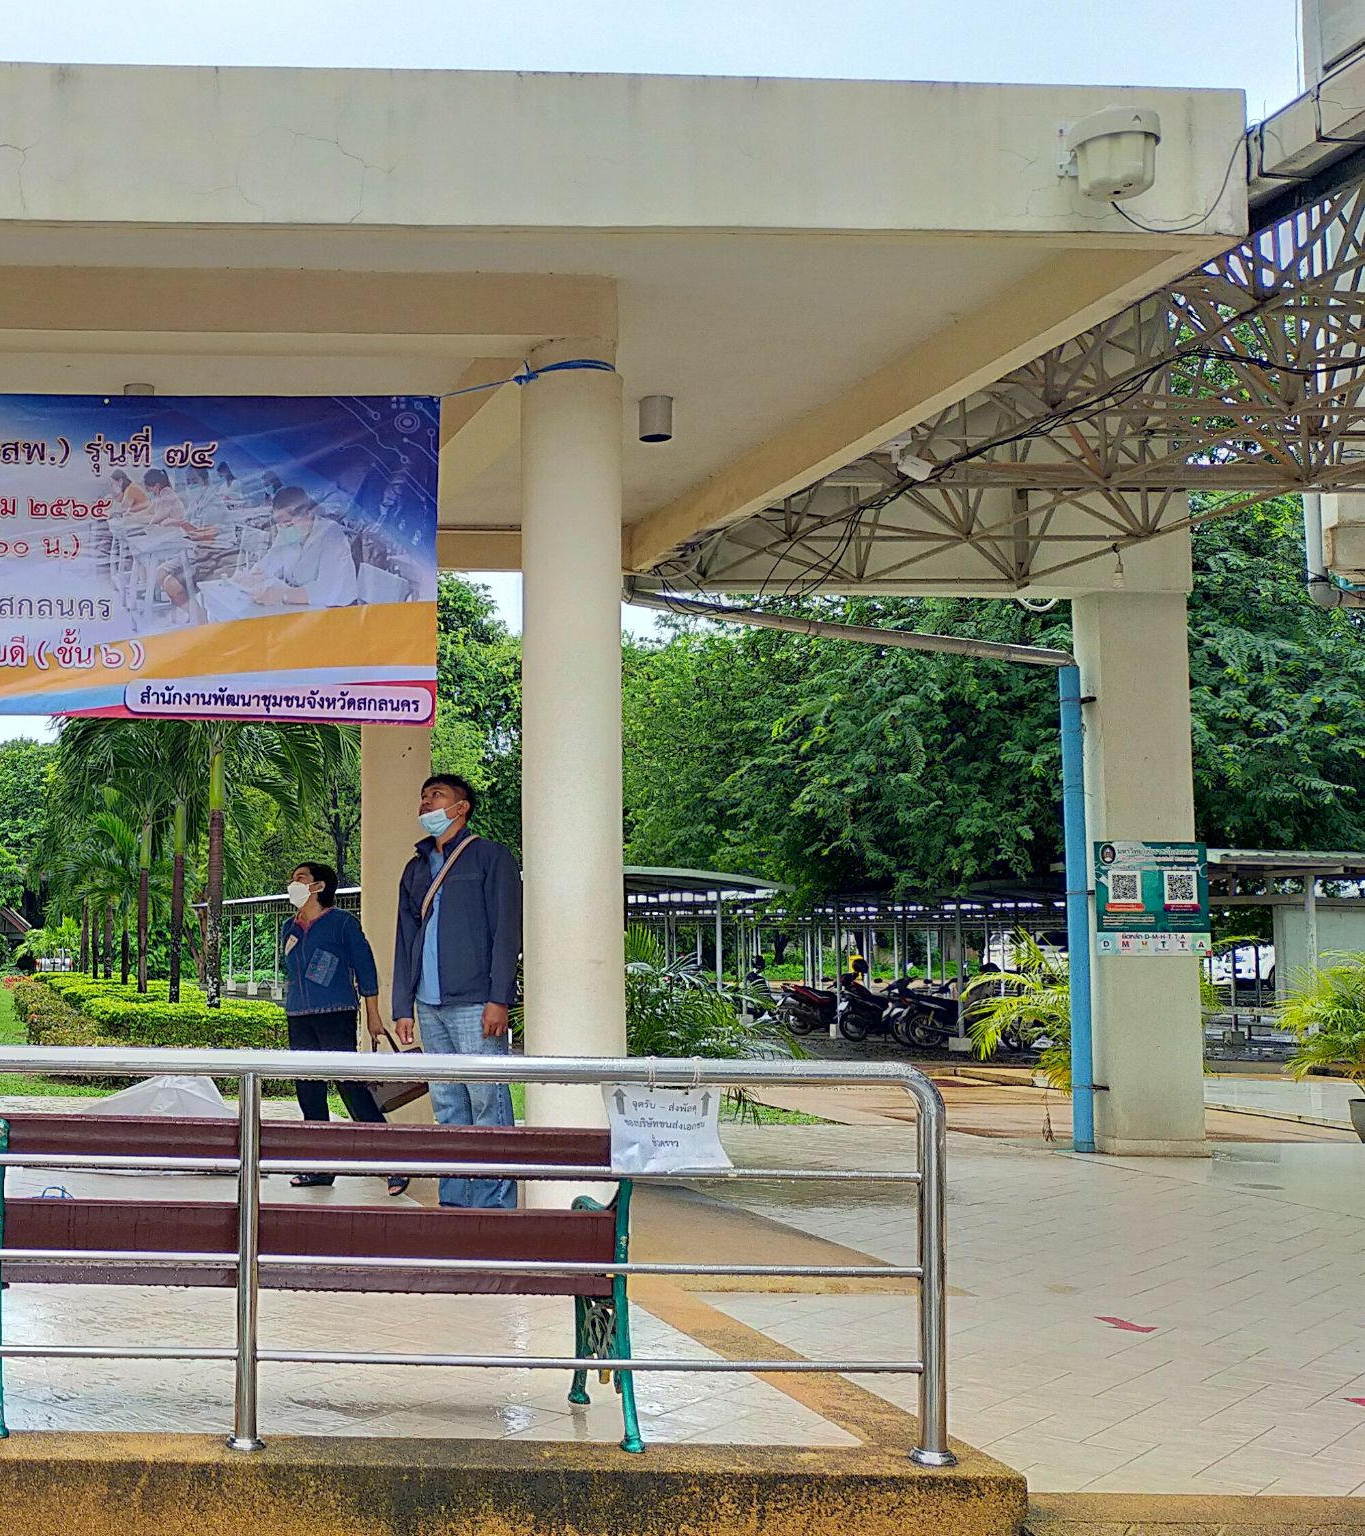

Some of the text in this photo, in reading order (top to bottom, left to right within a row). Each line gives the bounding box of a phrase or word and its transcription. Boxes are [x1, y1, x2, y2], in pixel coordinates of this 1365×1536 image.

[85, 426, 153, 477] รุ่นที่
[165, 441, 218, 468] ๗๔
[28, 497, 113, 520] ๒๕๖๕
[140, 686, 420, 713] สำนักงานพัฒนาชุมชนจังหวัดสกลนคร
